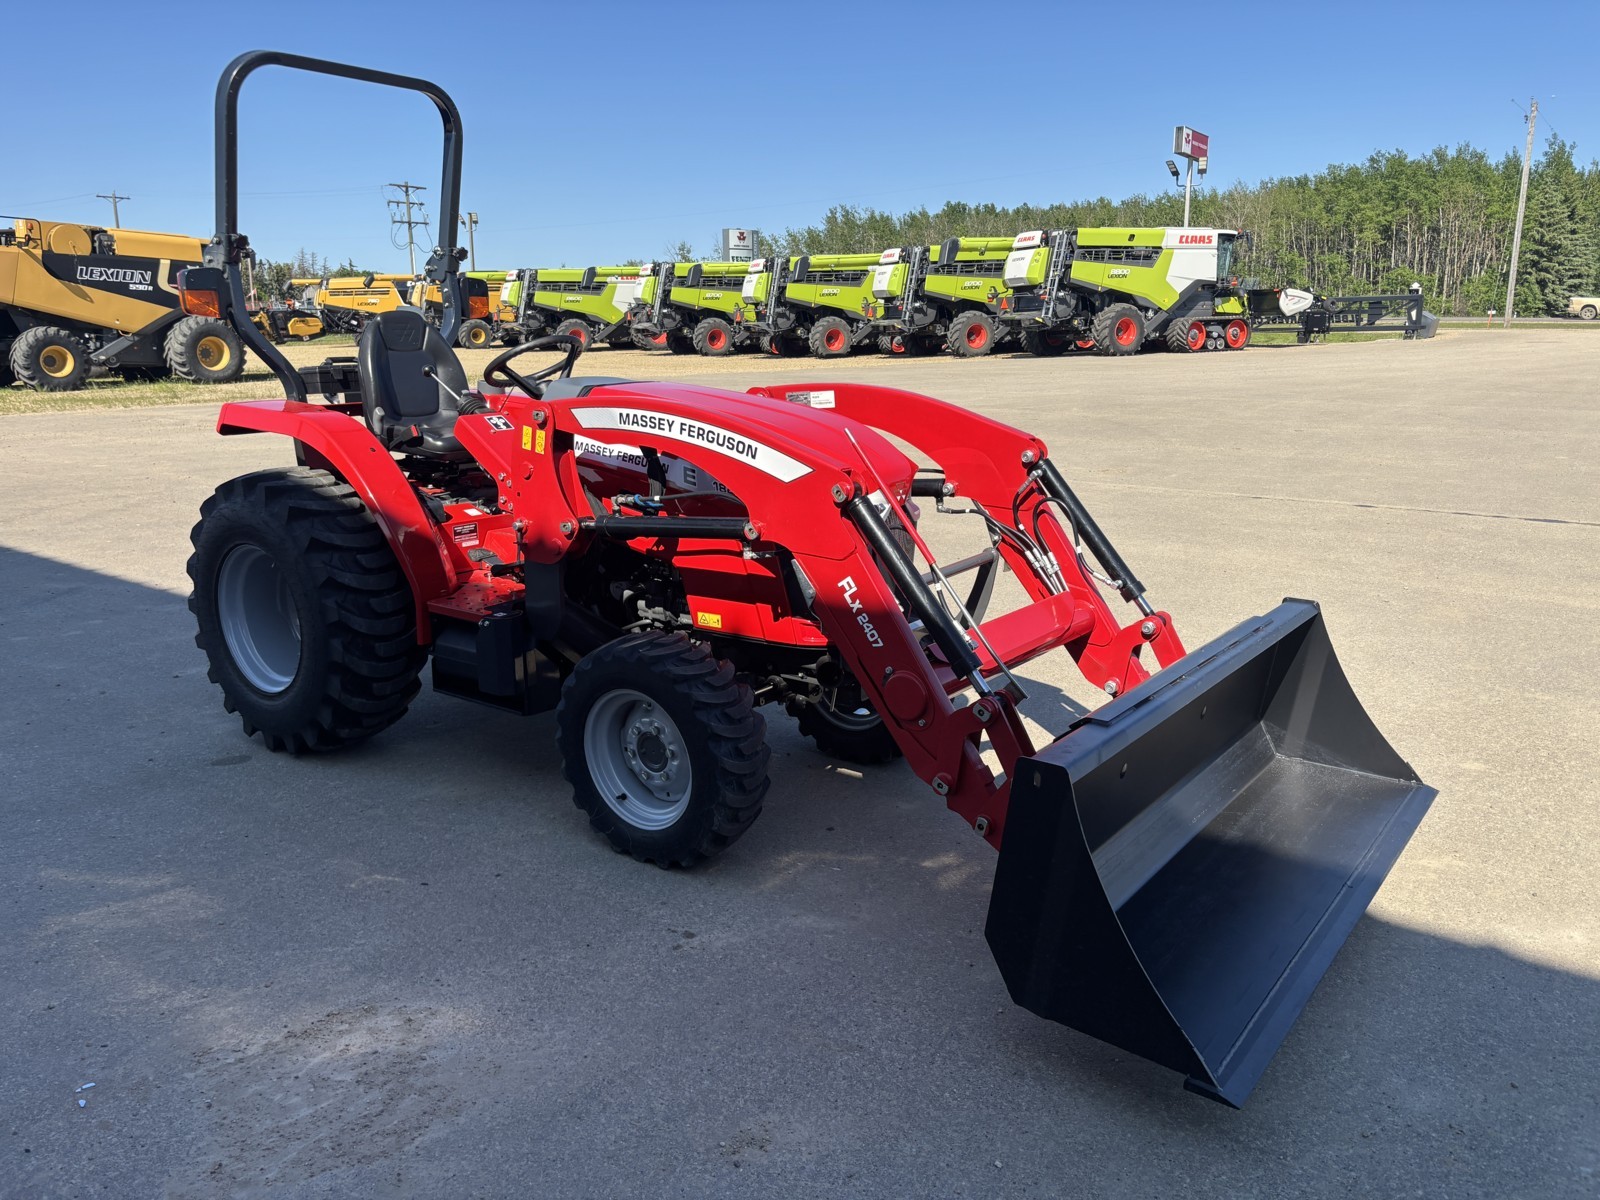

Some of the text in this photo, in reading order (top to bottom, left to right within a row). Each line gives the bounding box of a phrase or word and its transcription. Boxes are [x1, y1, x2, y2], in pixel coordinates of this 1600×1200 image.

[1179, 235, 1213, 244] CLAAS
[77, 266, 152, 284] LEXION
[619, 412, 758, 460] MASSEY FERGUSON
[574, 440, 670, 474] MASSEY FERGUN
[837, 575, 884, 648] FLX 2407
